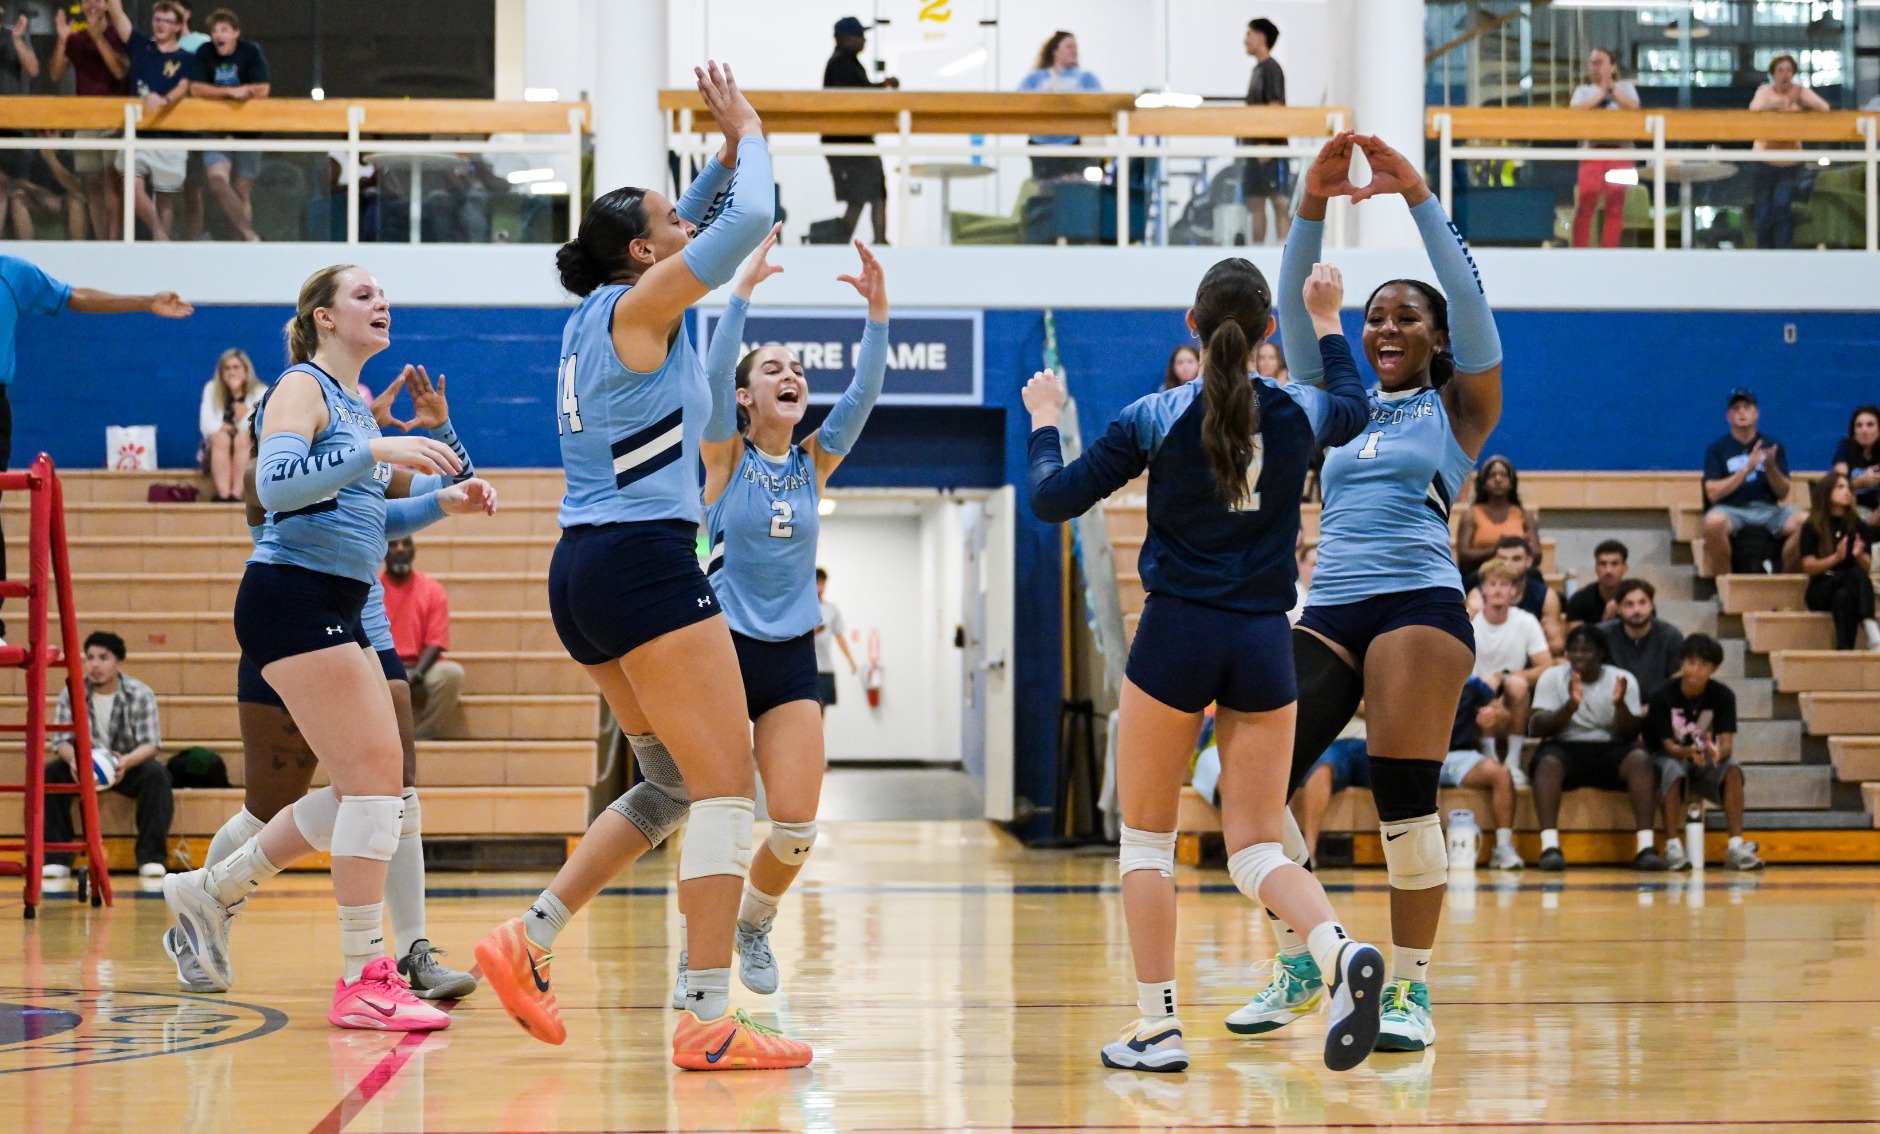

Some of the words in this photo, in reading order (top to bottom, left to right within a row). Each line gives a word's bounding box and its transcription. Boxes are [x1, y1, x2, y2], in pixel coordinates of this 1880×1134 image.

[1358, 430, 1385, 459] 1
[271, 450, 344, 481] DAME
[769, 499, 793, 538] 2
